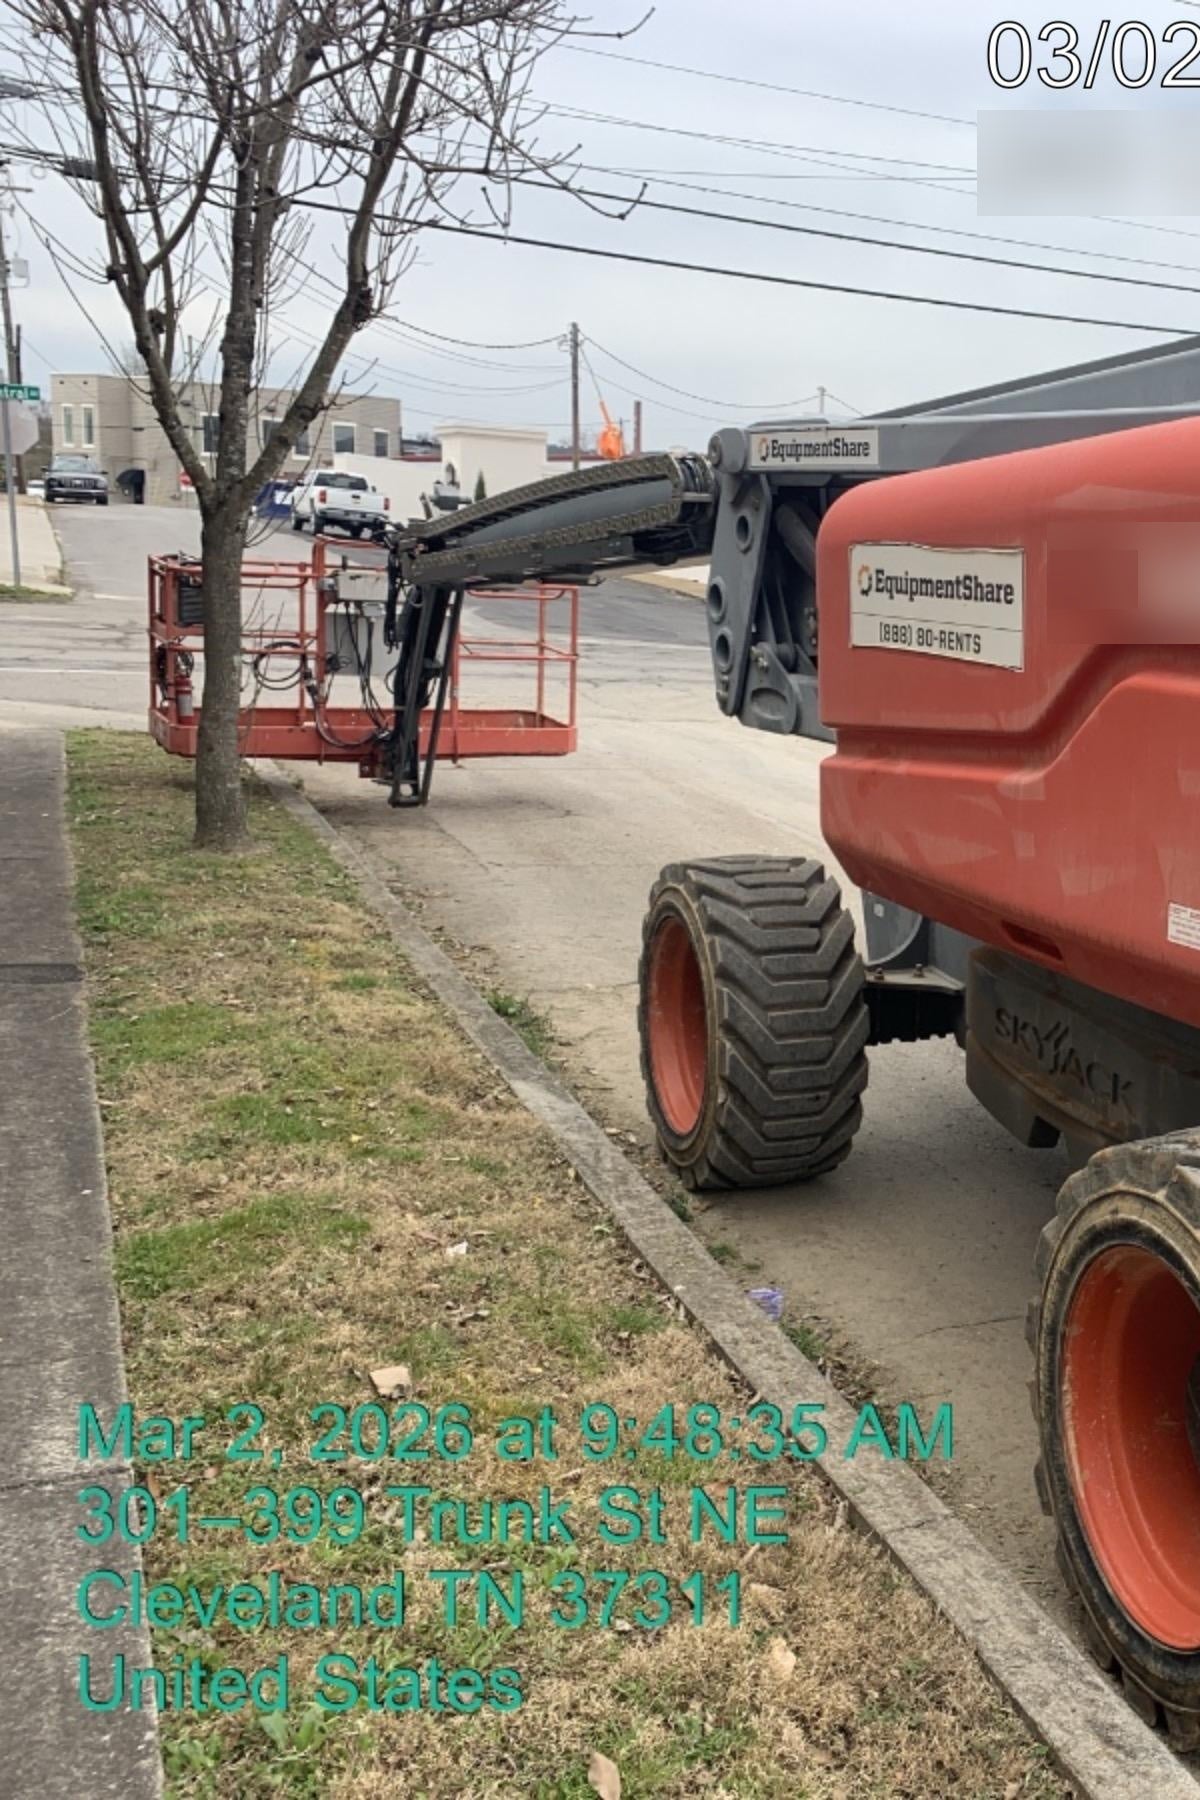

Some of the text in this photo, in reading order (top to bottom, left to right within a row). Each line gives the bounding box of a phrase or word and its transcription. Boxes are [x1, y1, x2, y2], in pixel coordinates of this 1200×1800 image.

[771, 437, 870, 462] EquipmentShare
[875, 568, 1014, 605] EquipmentShare
[879, 622, 981, 654] (888) 80-RENTS
[995, 1007, 1134, 1116] SKYJACK
